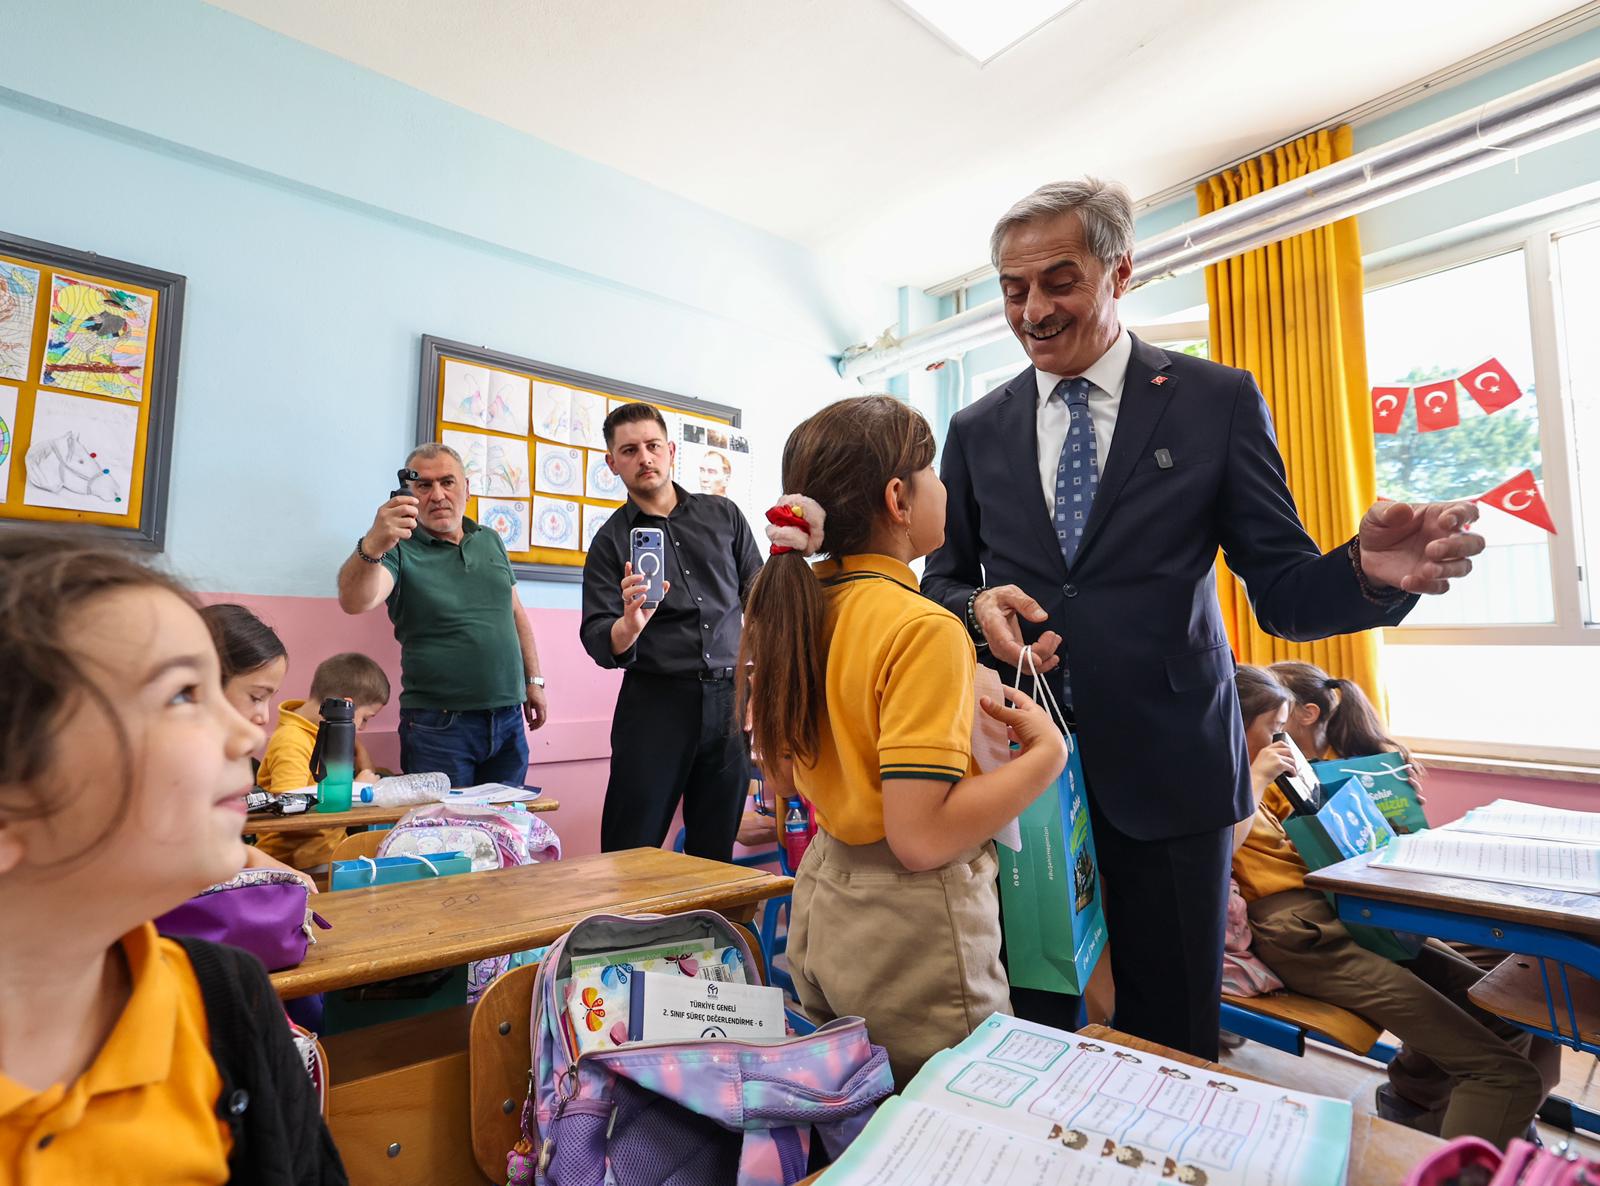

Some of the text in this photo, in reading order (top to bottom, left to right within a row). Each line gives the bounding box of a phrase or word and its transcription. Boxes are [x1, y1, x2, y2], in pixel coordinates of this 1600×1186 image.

[690, 1000, 736, 1012] TÜRKİYE GENELİ
[670, 1010, 685, 1018] SINIF
[686, 1012, 705, 1022] SÜREÇ
[706, 1014, 754, 1026] DEĞERLENDİRME
